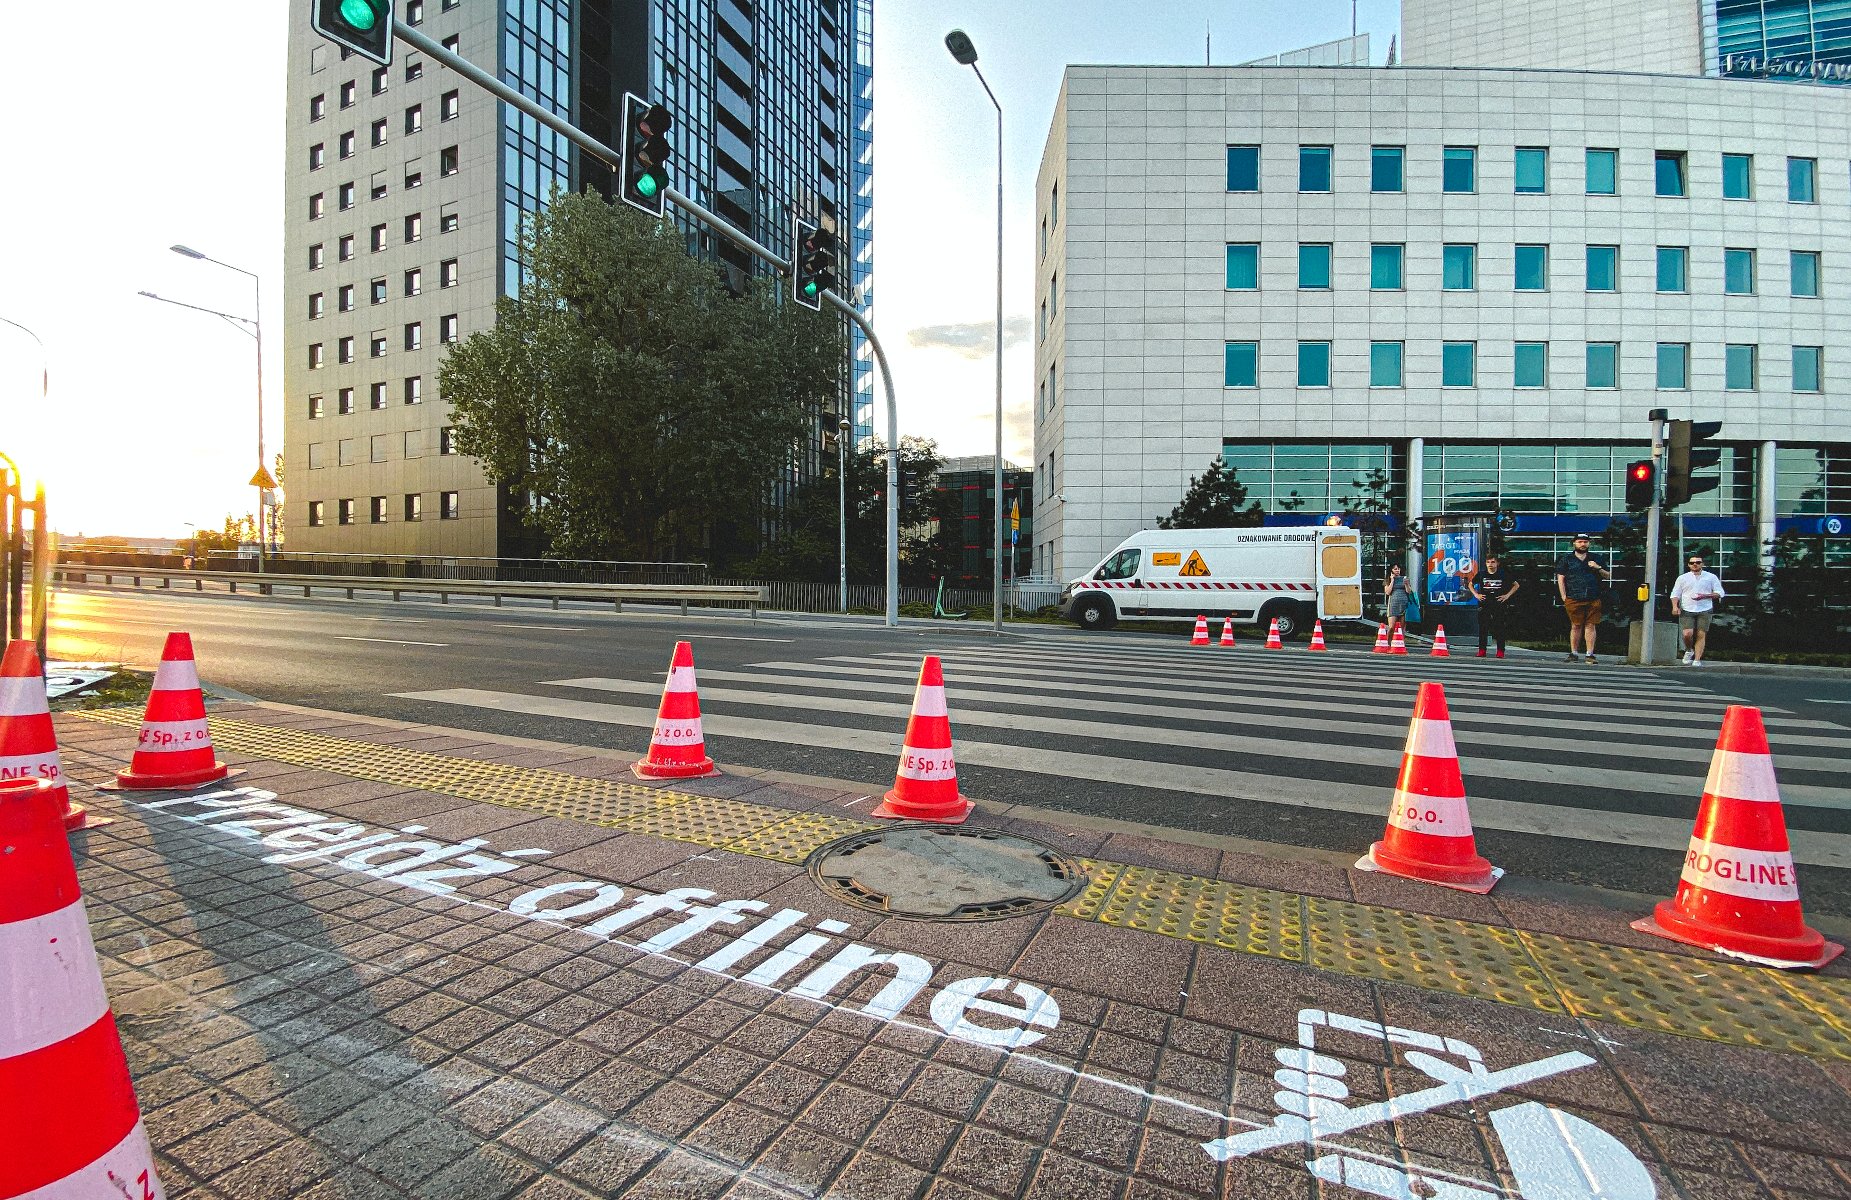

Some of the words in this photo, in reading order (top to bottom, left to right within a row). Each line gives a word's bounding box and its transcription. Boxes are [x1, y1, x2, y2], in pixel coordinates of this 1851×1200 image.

[1238, 534, 1282, 543] OZNAKOWANIE
[1284, 534, 1316, 542] DROGOWE
[1432, 557, 1472, 575] 100
[1430, 591, 1456, 602] LAT
[153, 731, 178, 746] Sp.
[673, 729, 696, 738] o.o.
[918, 758, 938, 773] Sp.
[1406, 807, 1443, 824] o.o.
[508, 881, 1061, 1048] offline
